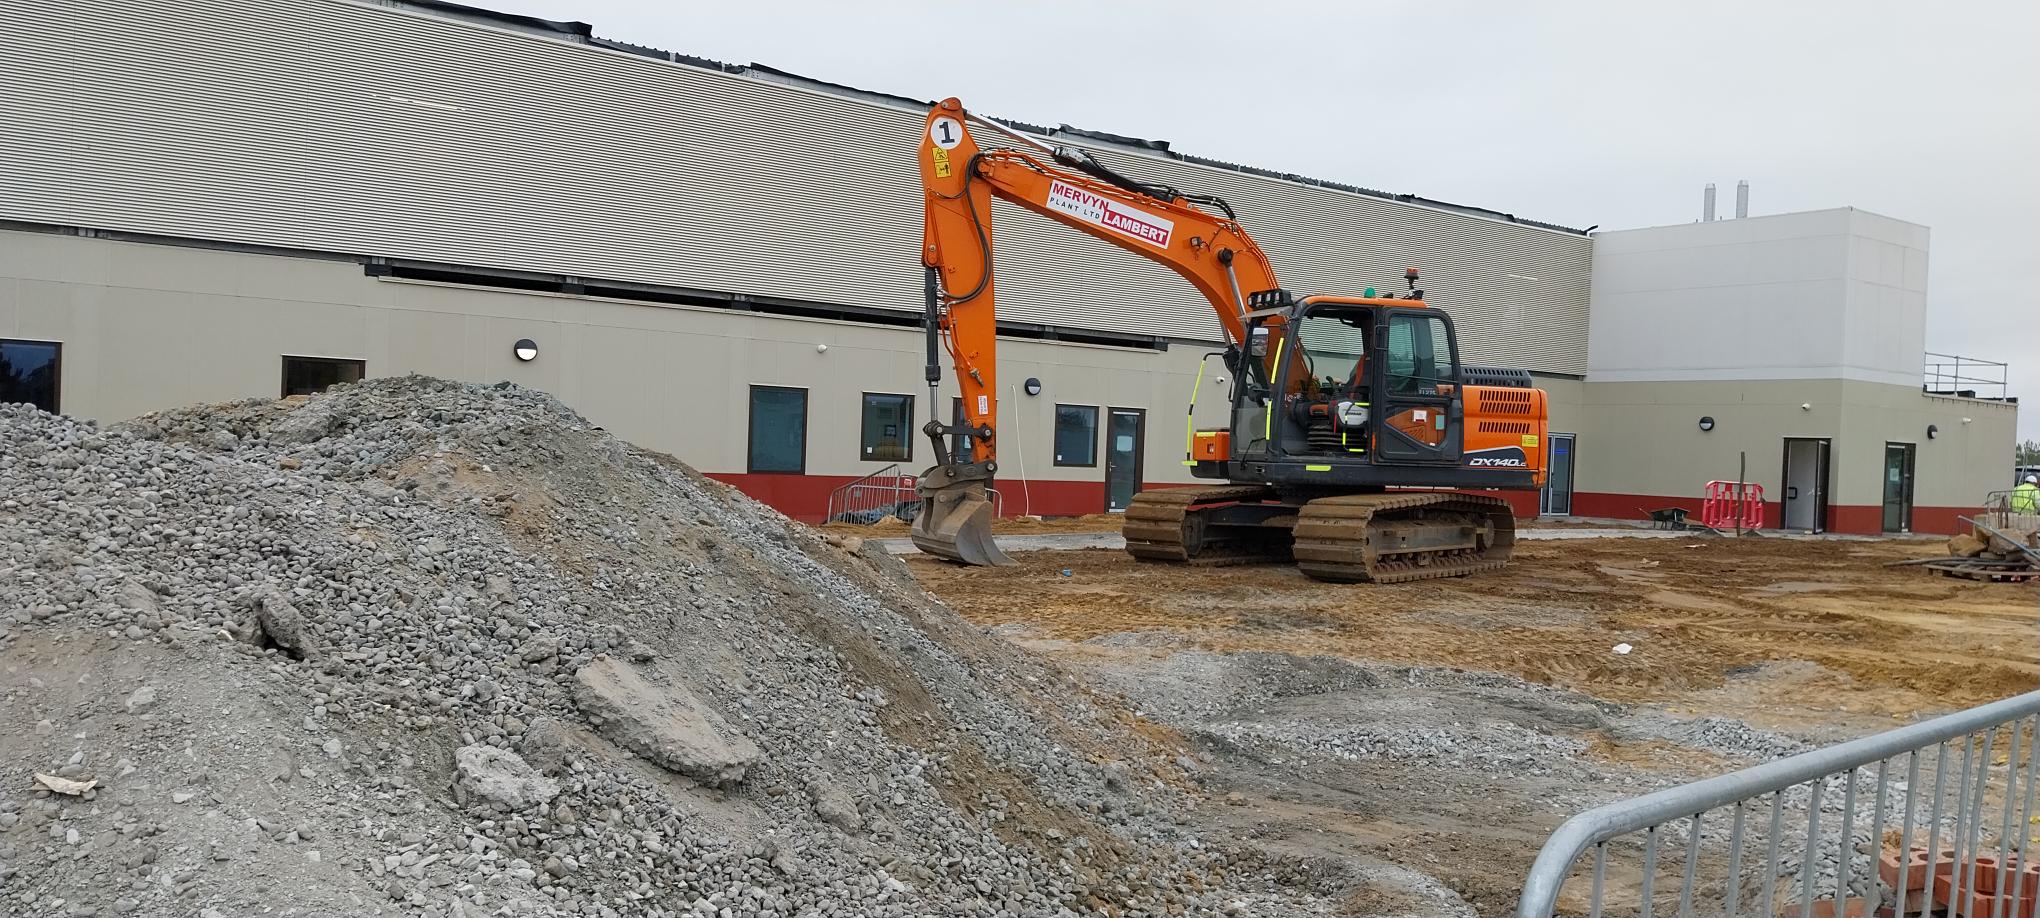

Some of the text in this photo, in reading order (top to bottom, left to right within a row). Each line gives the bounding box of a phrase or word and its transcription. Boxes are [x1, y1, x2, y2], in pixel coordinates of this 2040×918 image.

[938, 120, 956, 144] 1
[1049, 197, 1101, 220] PLANT LTD
[1052, 183, 1109, 211] MERVYN
[1103, 211, 1167, 242] LAMBERT
